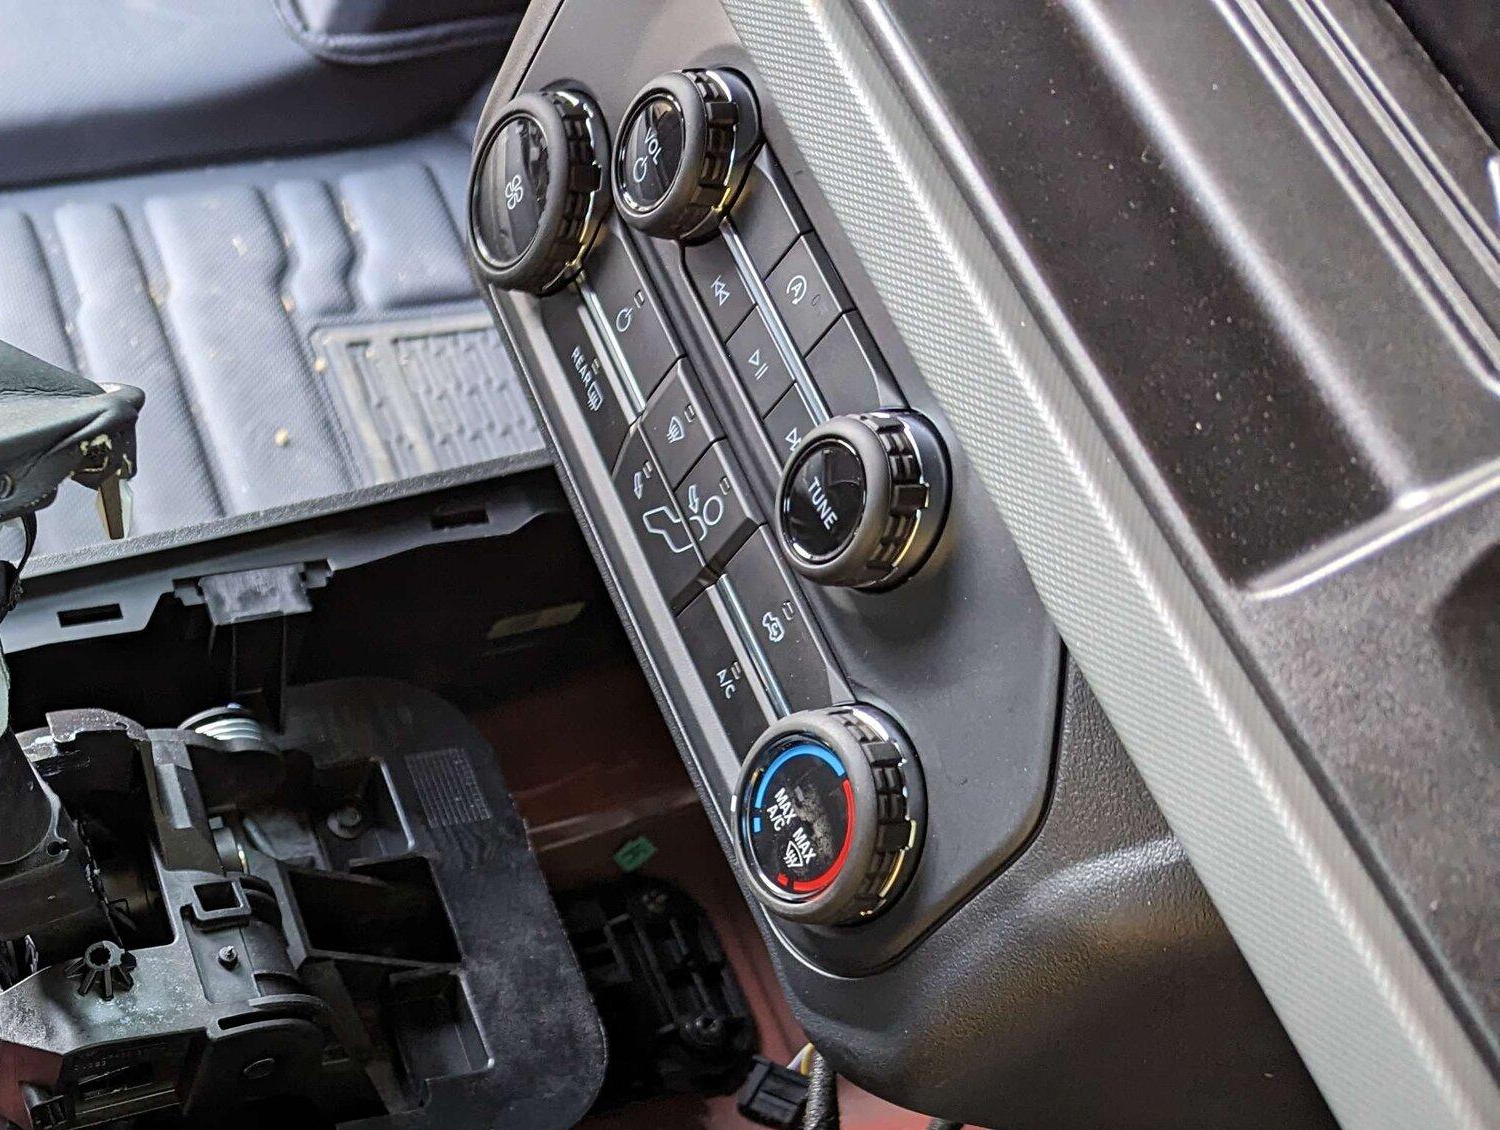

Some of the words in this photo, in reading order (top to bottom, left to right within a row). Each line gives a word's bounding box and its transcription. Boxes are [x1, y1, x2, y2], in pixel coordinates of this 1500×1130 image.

[644, 126, 662, 165] VOL
[571, 345, 593, 388] REAR
[808, 476, 838, 530] TUNE
[716, 668, 736, 699] A/C
[766, 804, 786, 832] A/C
[774, 787, 797, 825] MAX
[793, 826, 817, 865] MAX
